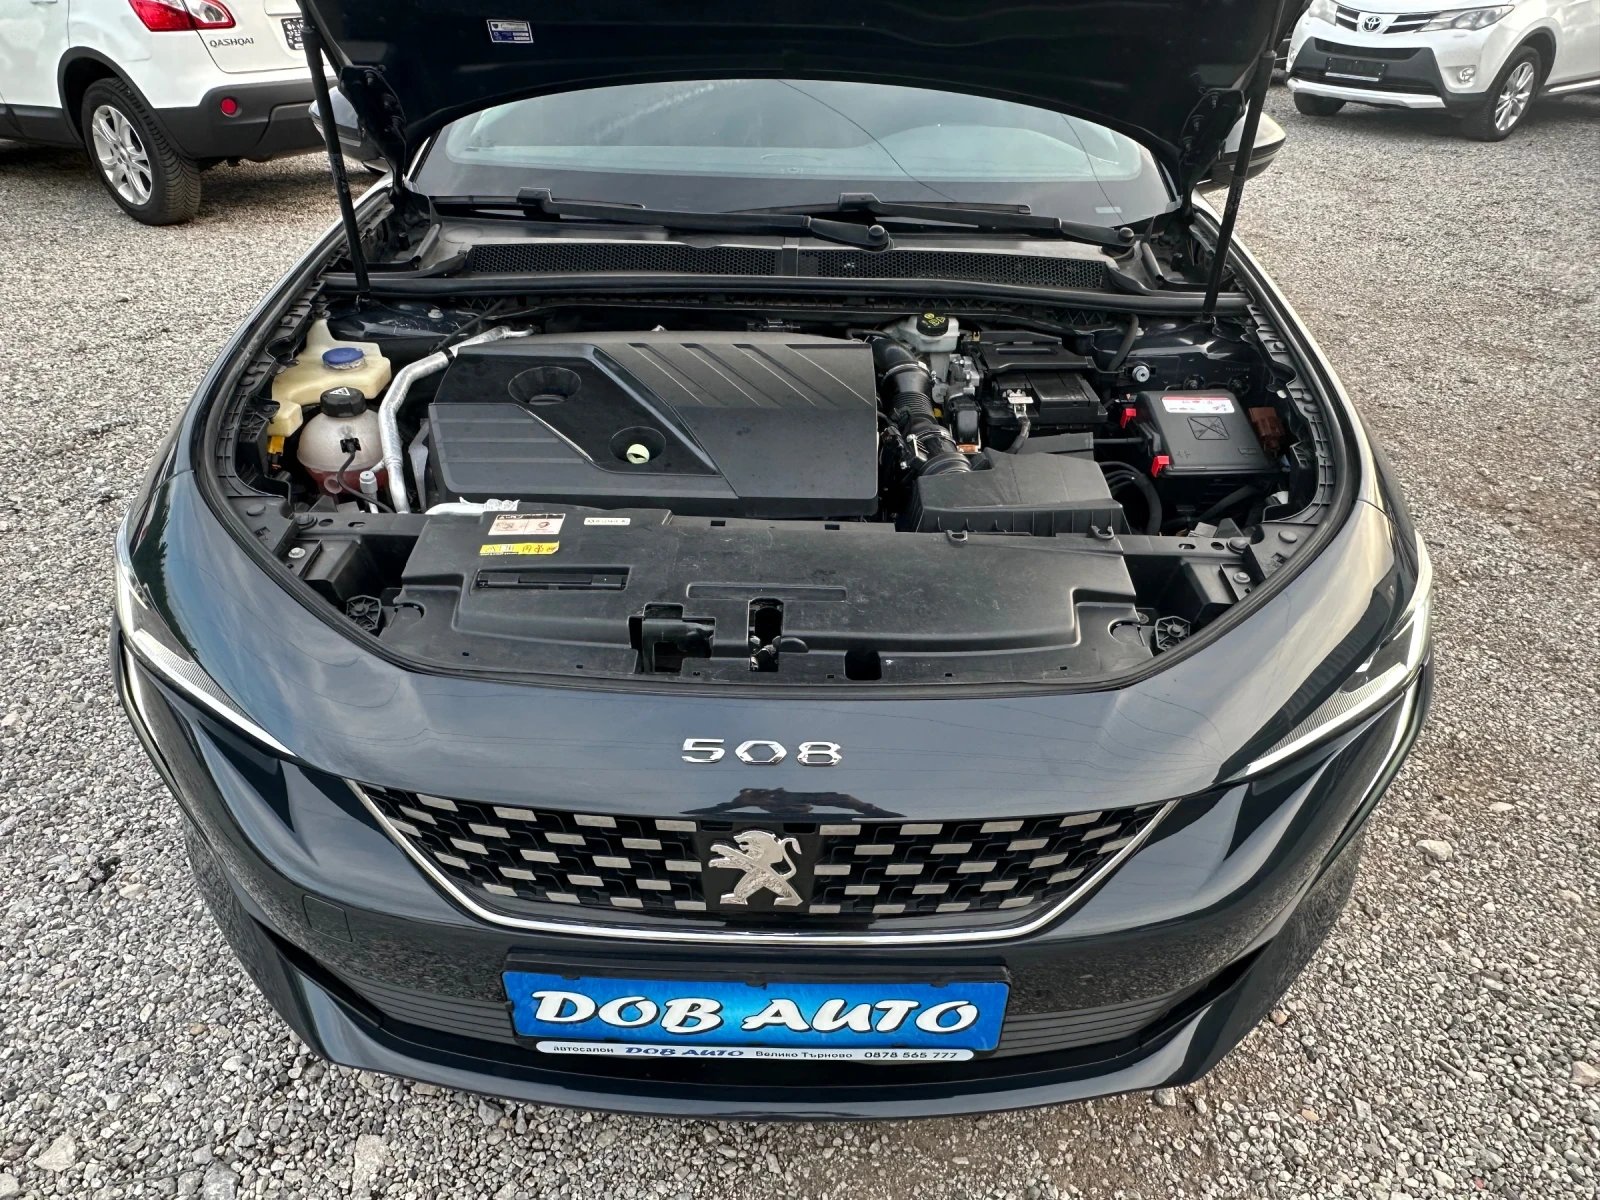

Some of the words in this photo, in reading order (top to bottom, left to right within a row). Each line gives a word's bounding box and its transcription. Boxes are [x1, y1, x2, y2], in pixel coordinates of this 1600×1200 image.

[209, 37, 255, 49] QASHQAI
[681, 738, 843, 767] 508
[531, 990, 724, 1035] DOB
[740, 998, 980, 1034] AUTO
[553, 1045, 614, 1053] автосалон
[624, 1046, 676, 1056] DOB
[681, 1048, 744, 1057] AUTO
[755, 1050, 798, 1058] Велико
[801, 1051, 853, 1059] Търново
[864, 1051, 898, 1059] 0878
